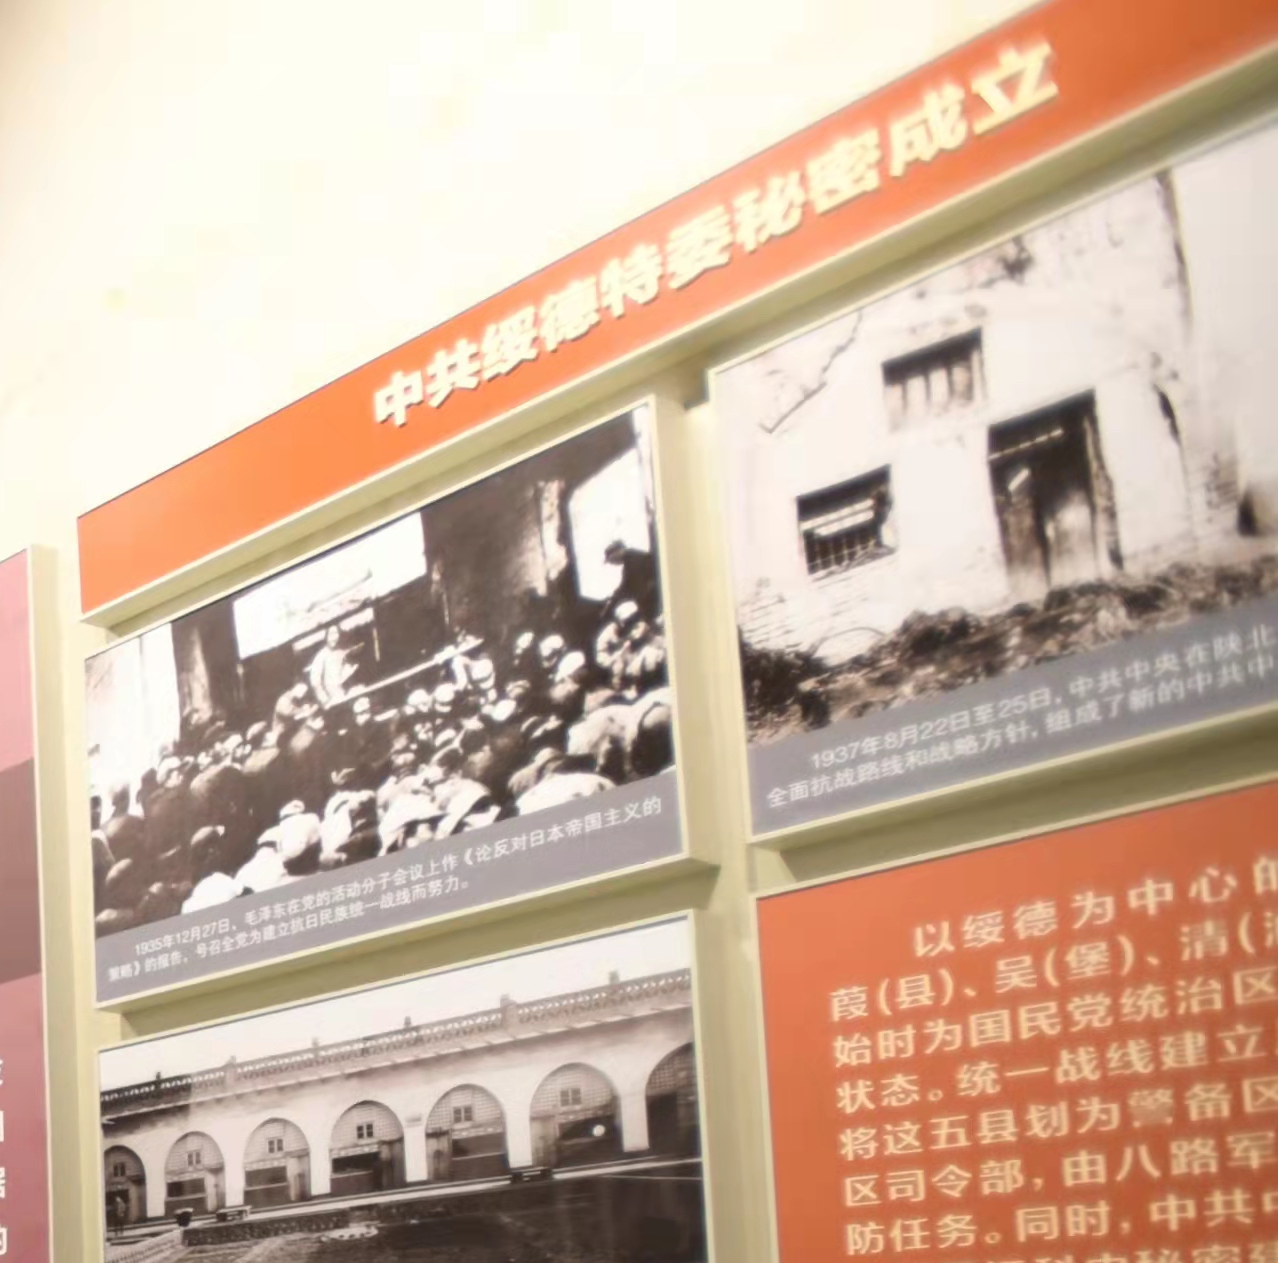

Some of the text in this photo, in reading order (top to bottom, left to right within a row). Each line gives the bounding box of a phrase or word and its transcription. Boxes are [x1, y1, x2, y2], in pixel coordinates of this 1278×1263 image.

[372, 40, 1059, 428] 中共绥德特委秘密成立
[833, 966, 1278, 1067] 始时为国民党统治区
[836, 1018, 1278, 1114] 状态。统一战线建立
[838, 1077, 1278, 1161] 将这五县划为警备区
[843, 1131, 1278, 1208] 区司令部，由八路军
